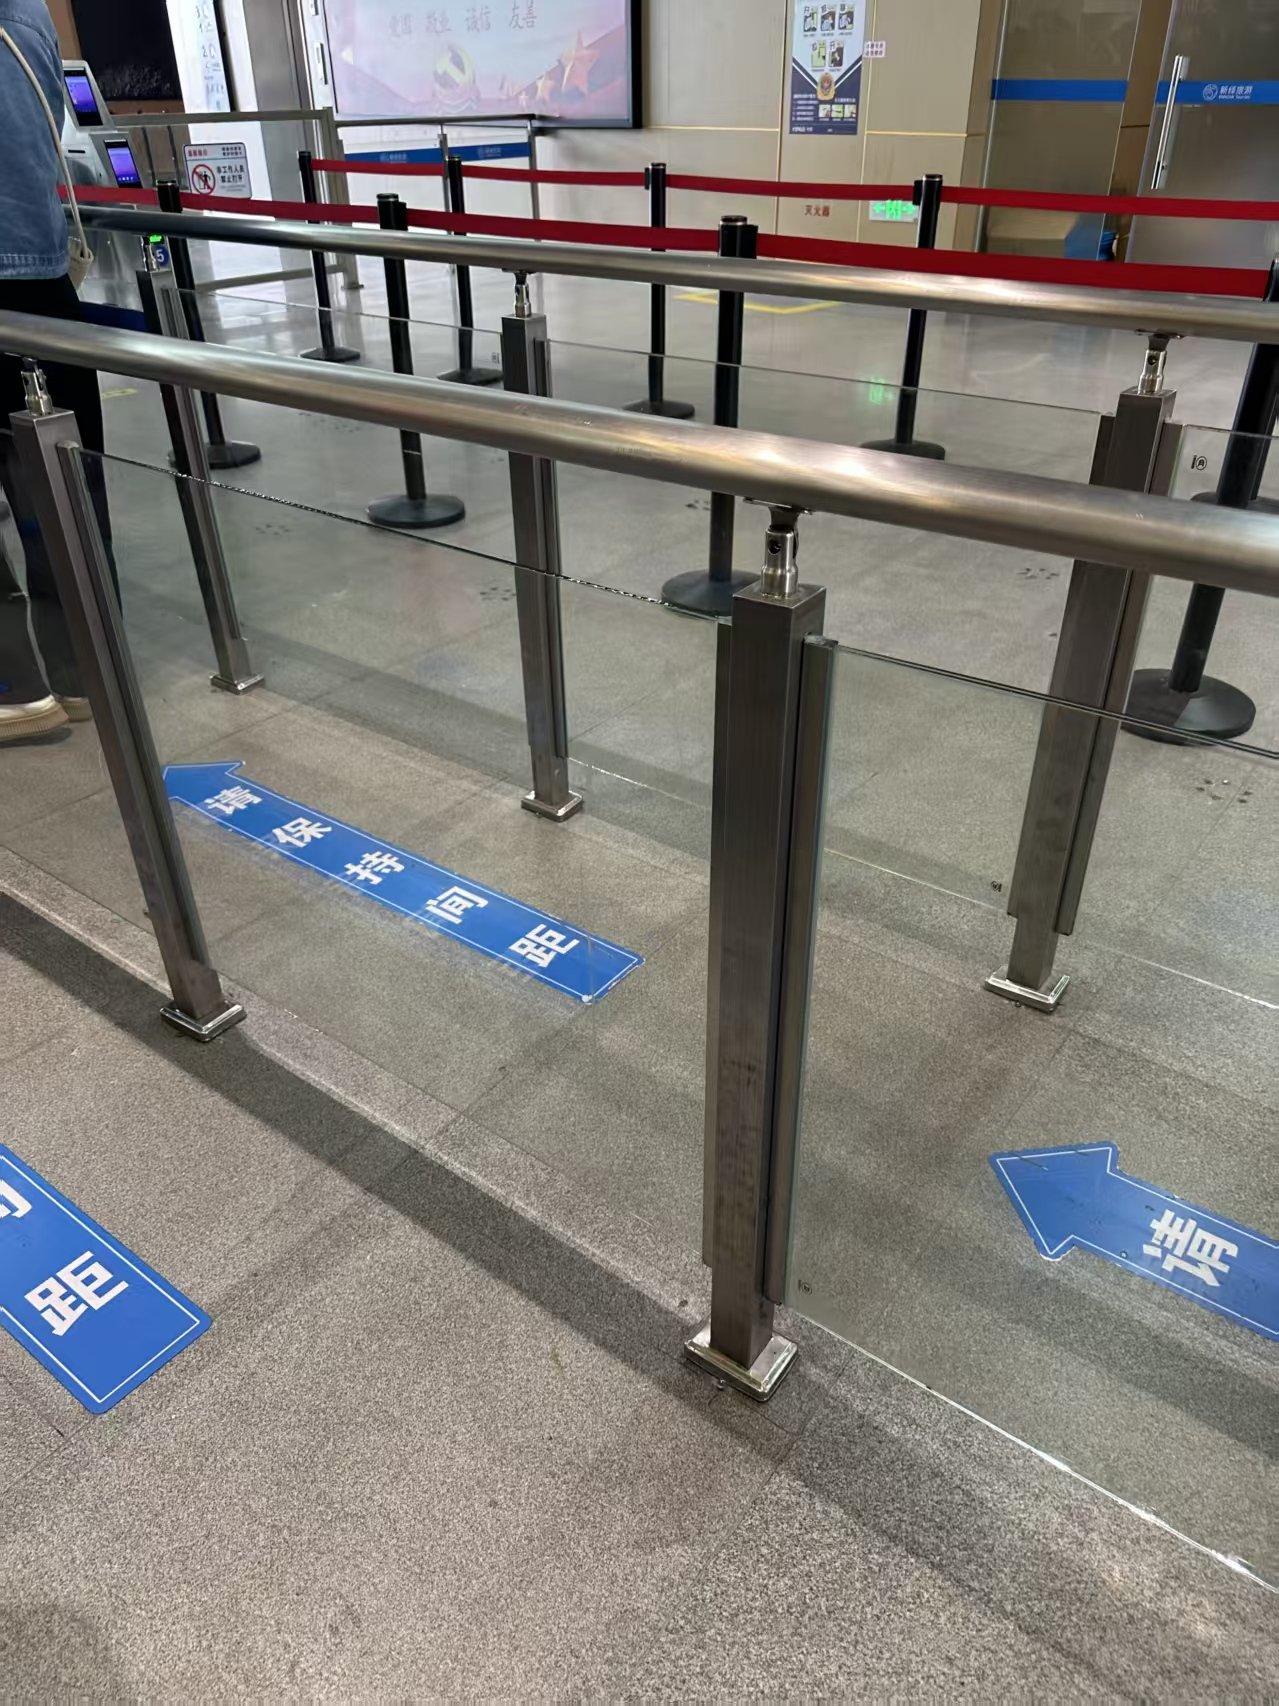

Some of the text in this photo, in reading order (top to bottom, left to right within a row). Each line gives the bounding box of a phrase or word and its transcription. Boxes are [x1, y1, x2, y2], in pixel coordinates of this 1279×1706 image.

[465, 5, 491, 32] 诚信
[509, 0, 537, 29] 友善
[804, 204, 830, 217] 灭火器
[156, 249, 165, 262] 5
[1143, 1209, 1239, 1287] 请
